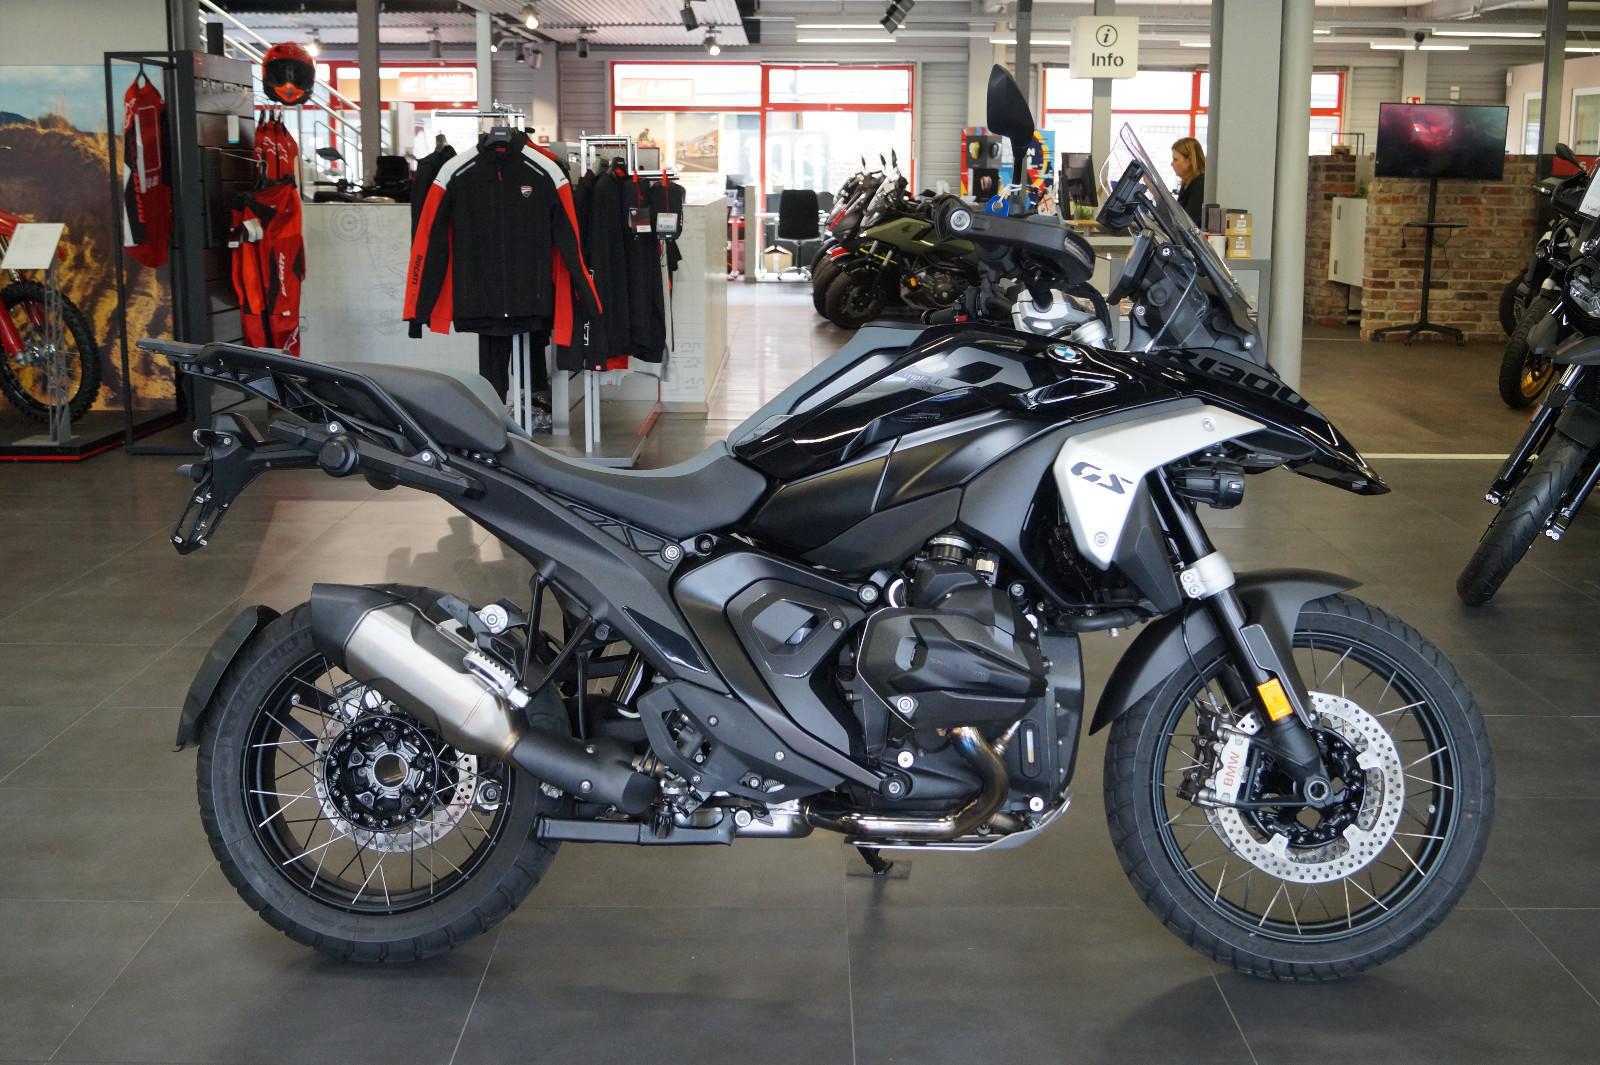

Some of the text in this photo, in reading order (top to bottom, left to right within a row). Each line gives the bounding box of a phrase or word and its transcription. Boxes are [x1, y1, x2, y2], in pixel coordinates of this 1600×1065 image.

[1091, 51, 1125, 68] Info
[1070, 461, 1134, 495] GS
[1223, 752, 1240, 788] BMW
